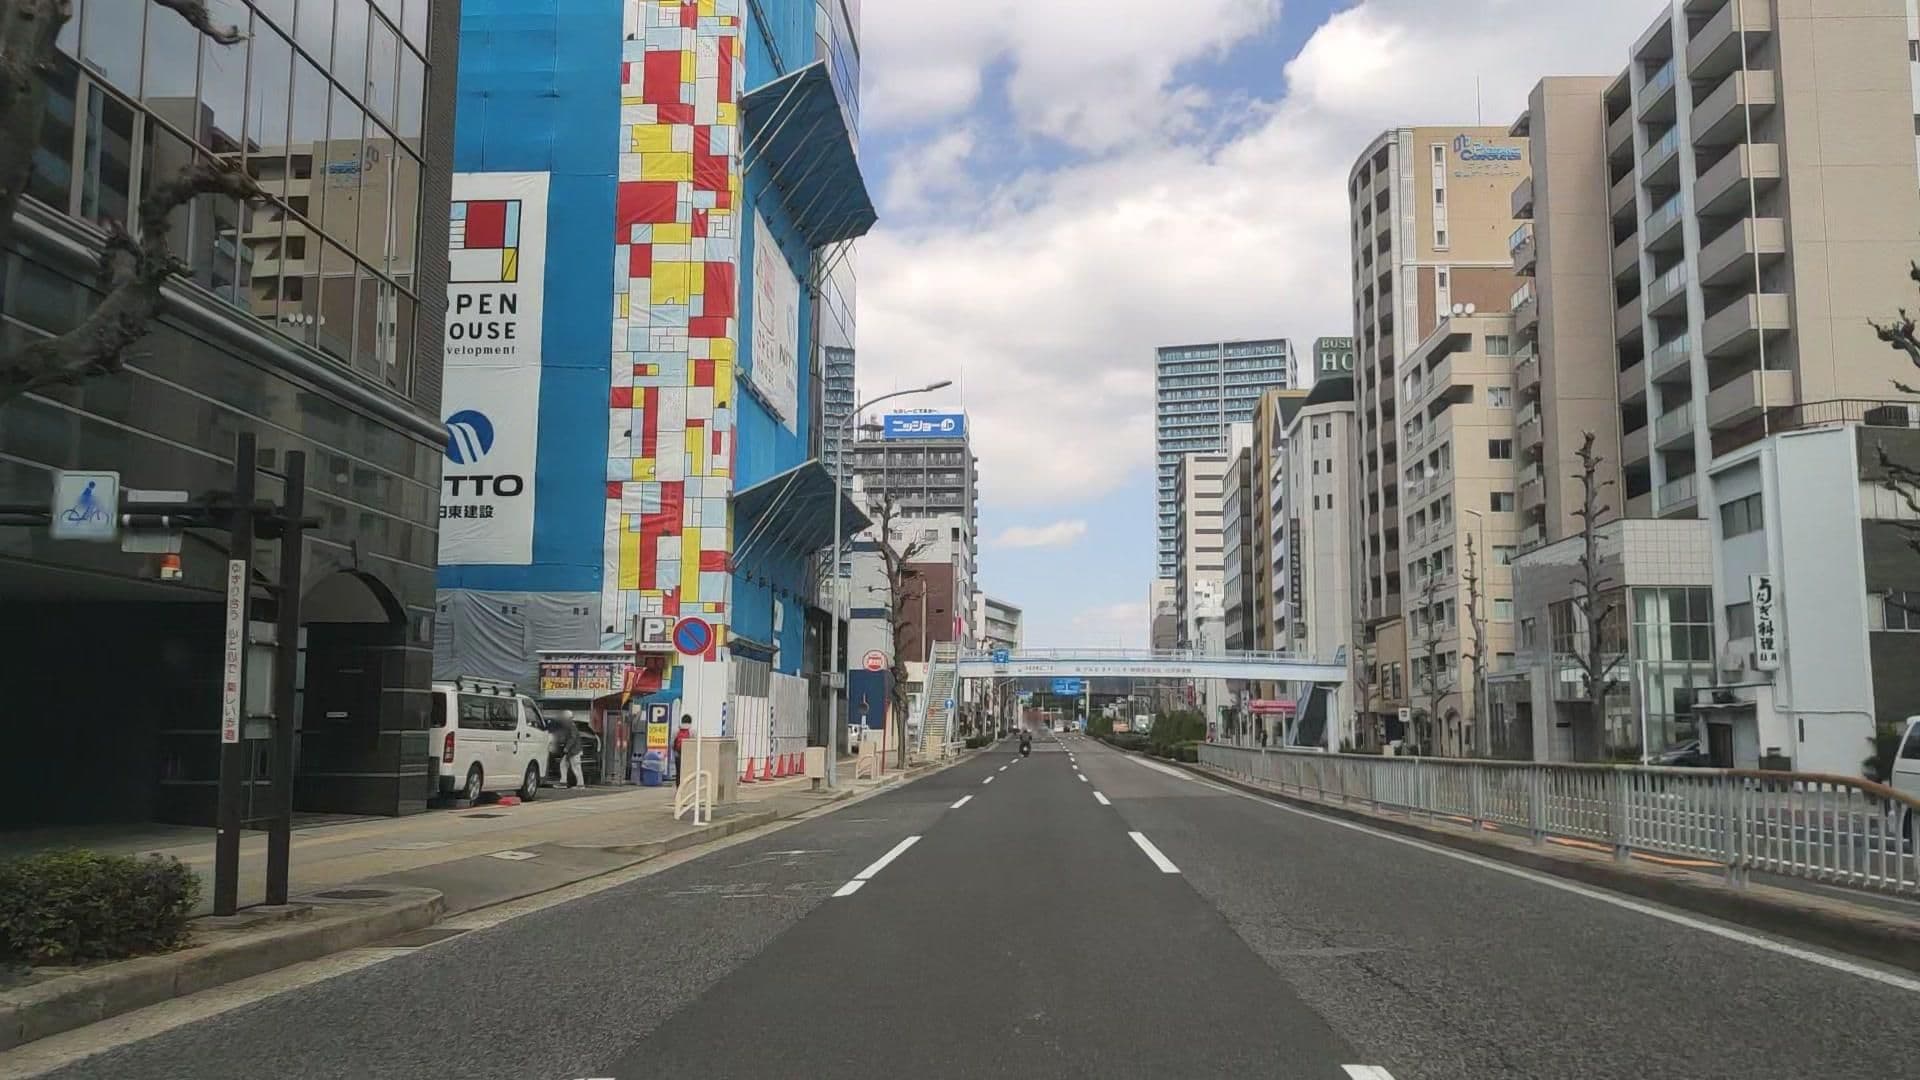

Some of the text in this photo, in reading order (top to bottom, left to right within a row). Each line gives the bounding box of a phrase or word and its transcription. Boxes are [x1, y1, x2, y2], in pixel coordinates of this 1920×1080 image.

[447, 293, 517, 315] PEN
[449, 321, 516, 340] OUSE
[447, 345, 516, 357] velopment
[1321, 351, 1354, 371] HO
[443, 474, 524, 497] TTO
[440, 505, 494, 519] 日東建設
[644, 618, 665, 642] P
[652, 706, 666, 722] P
